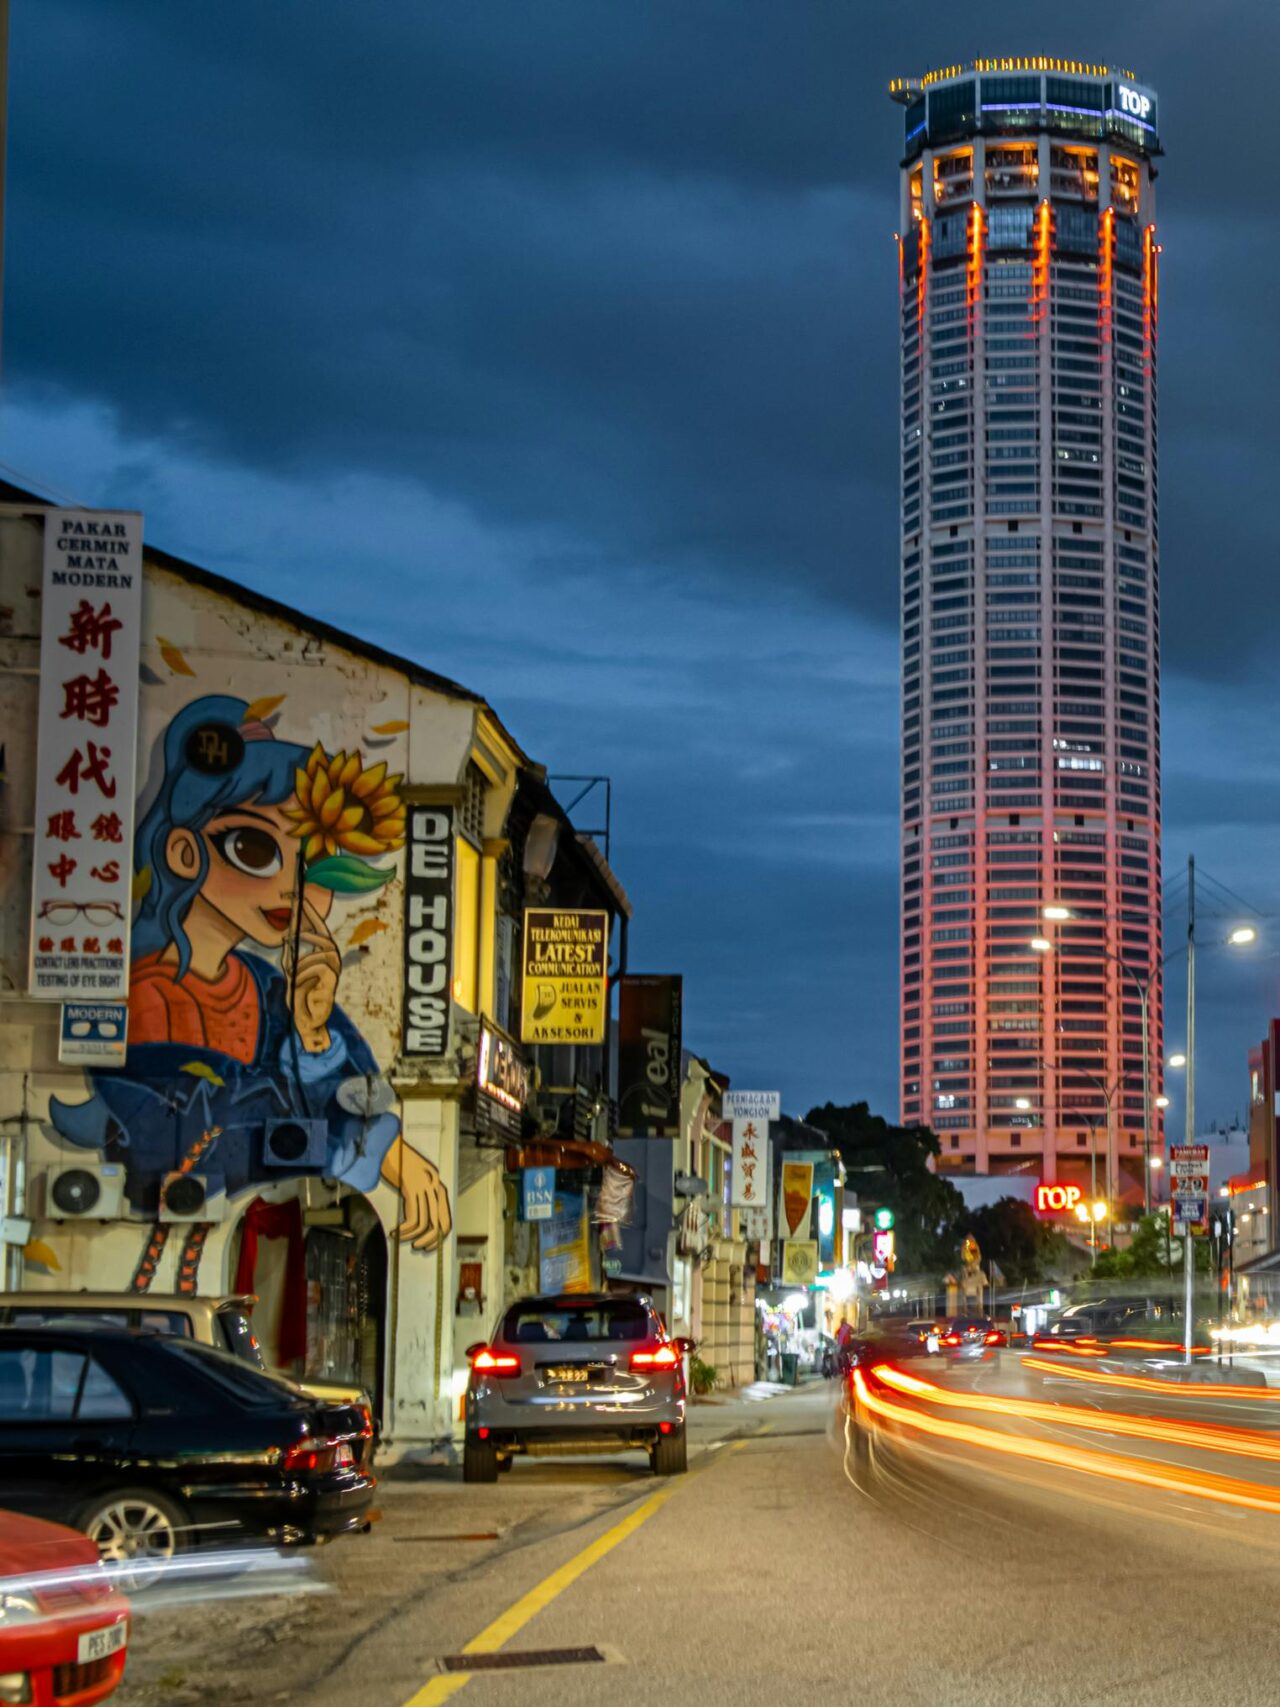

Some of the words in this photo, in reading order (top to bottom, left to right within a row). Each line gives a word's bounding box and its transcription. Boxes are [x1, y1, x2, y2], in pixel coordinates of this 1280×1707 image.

[1119, 85, 1151, 119] TOP
[62, 520, 126, 537] PAKAR
[57, 538, 130, 555] CERMIN
[67, 555, 119, 571] MATA
[52, 571, 133, 589] MODERN
[55, 599, 123, 798] 新時代
[411, 811, 449, 879] DE
[47, 853, 120, 888] 中心
[553, 914, 579, 928] KEDAI
[531, 927, 602, 942] TELEKOMUNIKASI
[535, 943, 596, 962] LATEST
[35, 956, 62, 969] CONTACT
[81, 957, 123, 970] PRACTITIONER
[528, 962, 600, 977] COMMUNICATION
[37, 974, 68, 987] TESTING
[70, 974, 80, 987] OF
[82, 975, 97, 987] EYE
[99, 975, 121, 988] SIGHT
[406, 895, 448, 1052] HOUSE
[560, 981, 600, 994] JUALAN
[561, 997, 598, 1009] SERVIS
[67, 1007, 123, 1021] MODERN
[574, 1012, 583, 1024] &
[532, 1027, 594, 1039] AKSESORI
[527, 1190, 553, 1204] BSN
[1038, 1186, 1081, 1210] TOP
